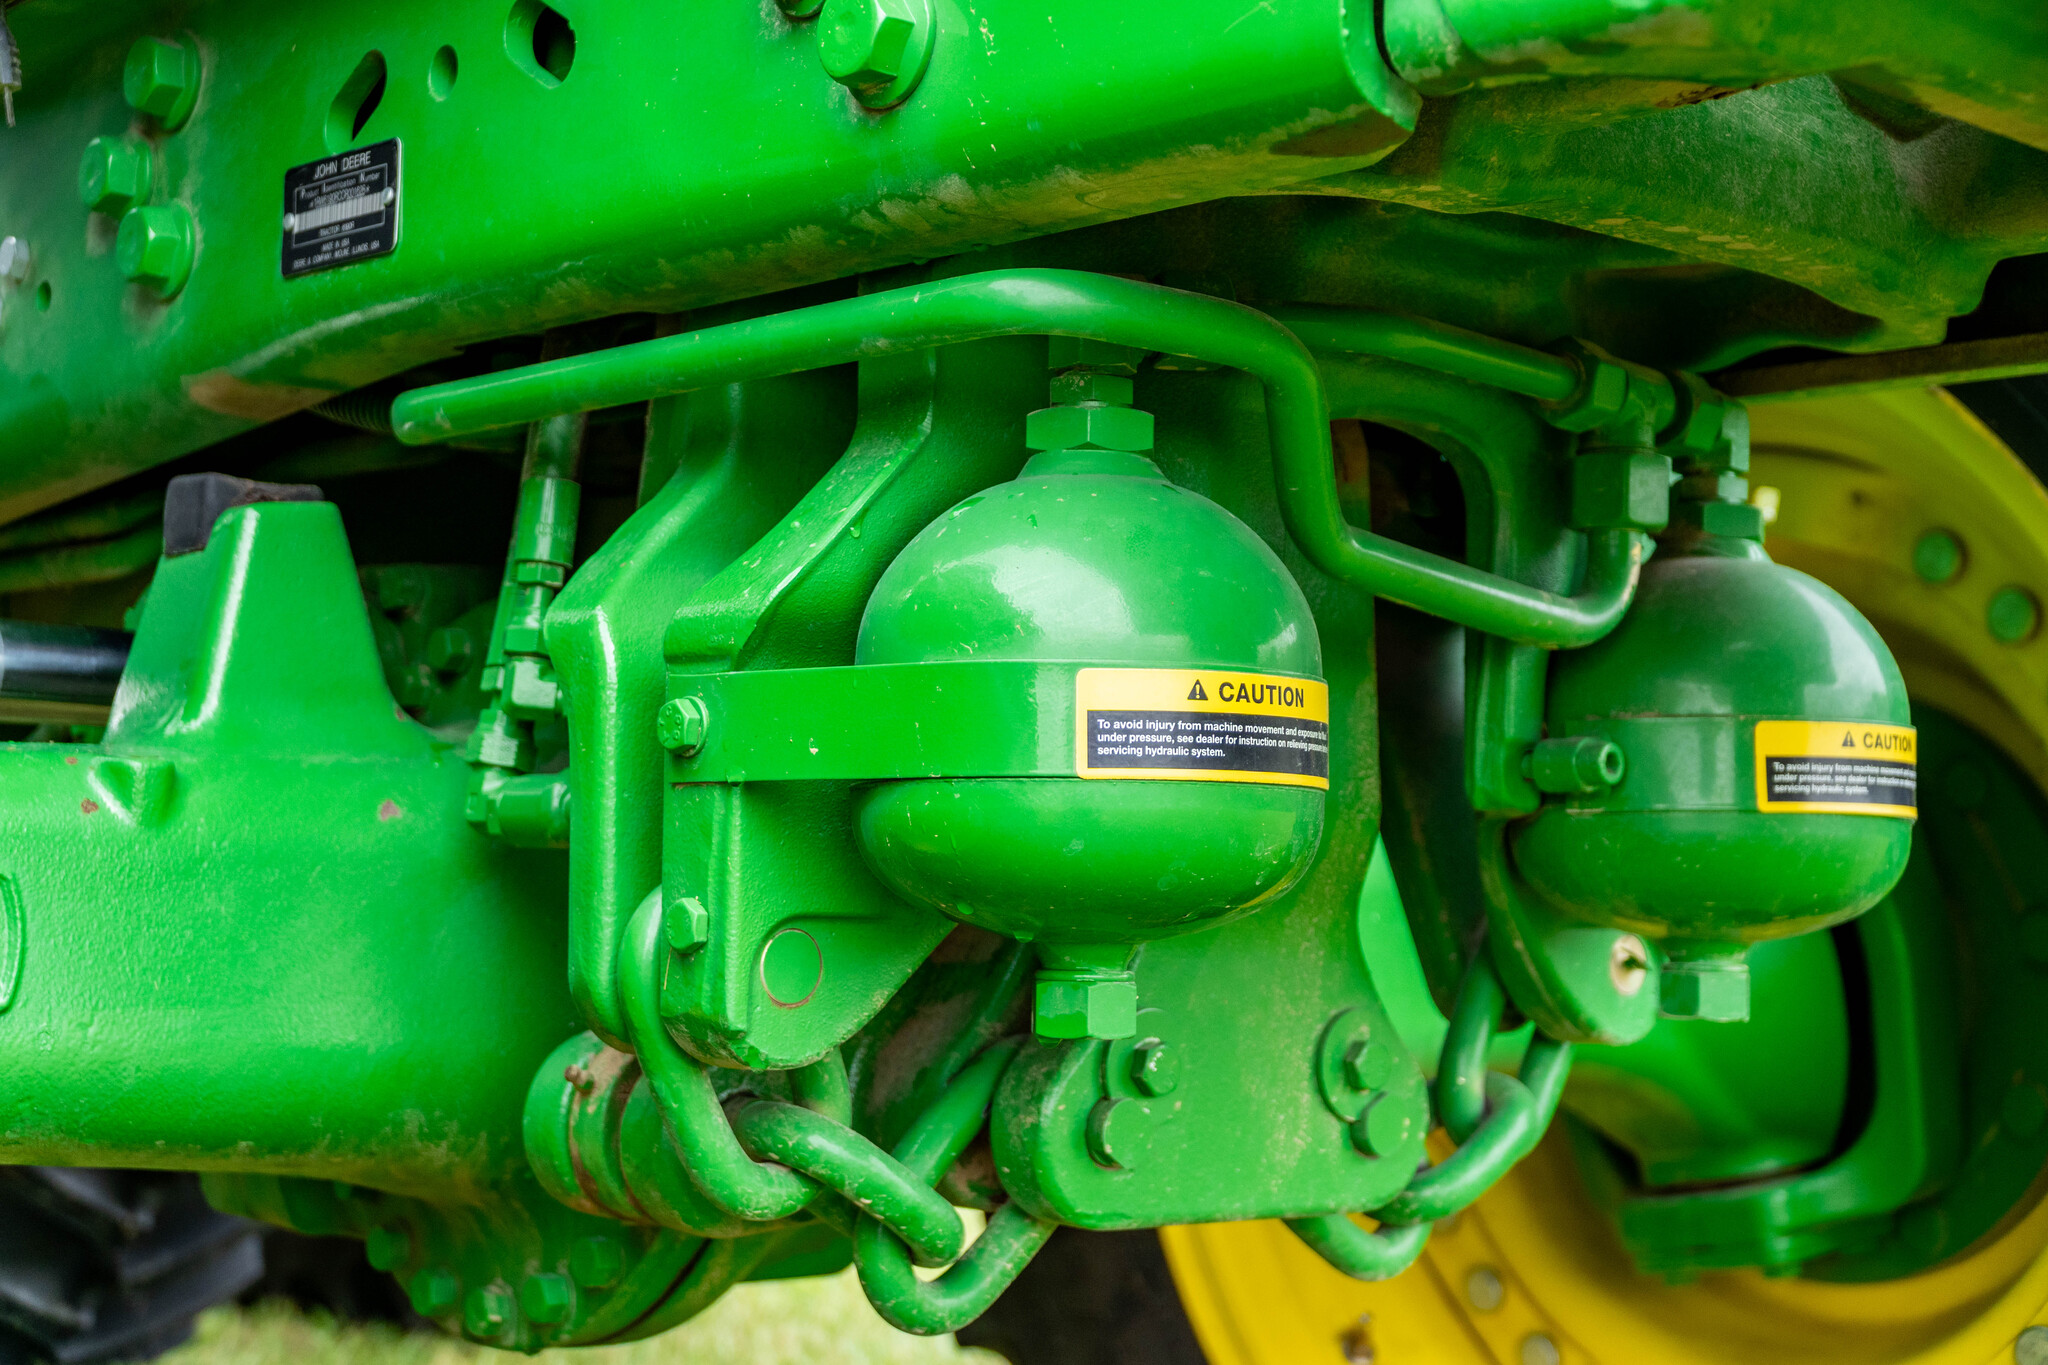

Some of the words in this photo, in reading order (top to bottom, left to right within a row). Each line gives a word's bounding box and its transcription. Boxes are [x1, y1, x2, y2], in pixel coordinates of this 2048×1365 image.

[315, 160, 338, 178] JOHN
[342, 151, 372, 170] DEERE
[360, 171, 381, 182] Number
[1219, 682, 1304, 708] CAUTION
[1097, 719, 1111, 729] To
[1113, 719, 1143, 730] avoid
[1145, 719, 1175, 732] injury
[1177, 720, 1201, 730] from
[1204, 721, 1243, 732] machine
[1245, 724, 1285, 735] movement
[1285, 727, 1297, 736] and
[1097, 732, 1127, 742] under
[1129, 733, 1175, 744] pressure,
[1177, 735, 1194, 743] see
[1196, 734, 1224, 744] dealer
[1225, 734, 1237, 745] for
[1238, 736, 1277, 747] instruction
[1278, 739, 1286, 747] on
[1286, 739, 1308, 752] relieving
[1863, 733, 1912, 752] CAUTION
[1097, 745, 1143, 757] servicing
[1145, 745, 1189, 757] hydraulic
[1191, 747, 1226, 758] system.
[1773, 761, 1785, 771] To
[1786, 761, 1810, 772] avoid
[1811, 762, 1834, 774] injury
[1835, 762, 1852, 773] from
[1774, 773, 1798, 783] under
[1774, 783, 1811, 795] servicing
